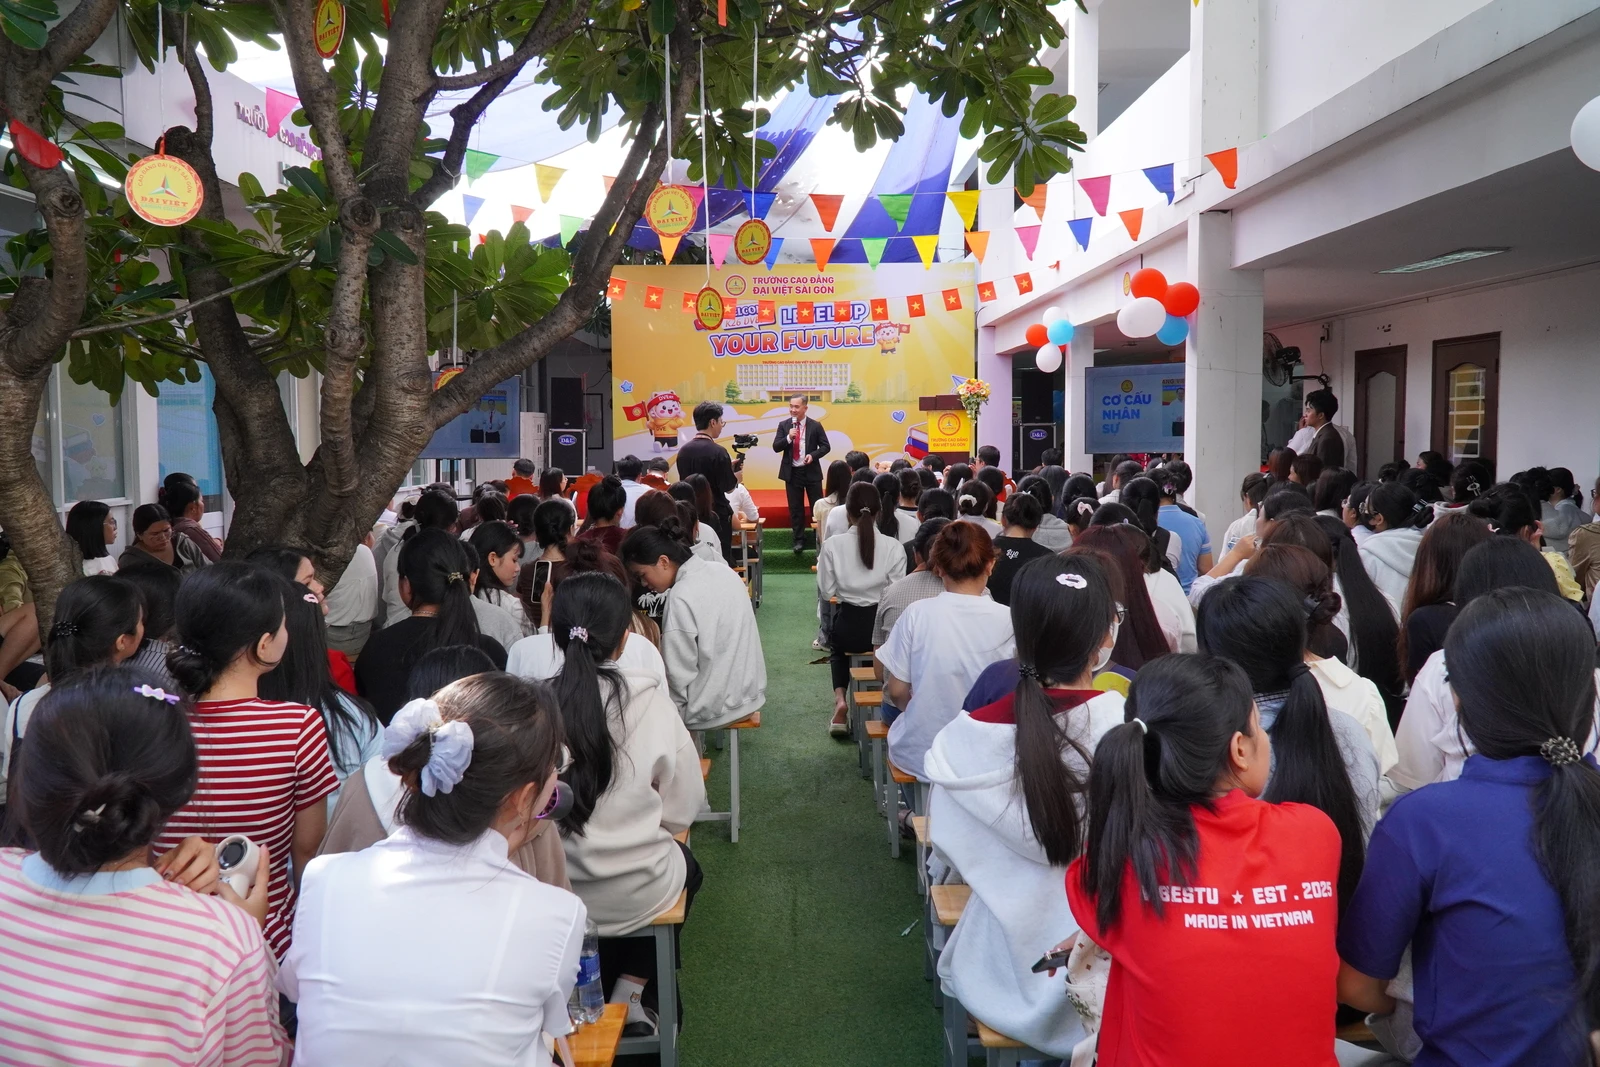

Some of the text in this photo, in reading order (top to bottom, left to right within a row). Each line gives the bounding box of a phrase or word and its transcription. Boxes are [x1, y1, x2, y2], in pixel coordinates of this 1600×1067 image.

[753, 274, 834, 284] TRƯỜNG CAO ĐẲNG
[753, 284, 834, 296] ĐẠI VIỆT SÀI GÒN
[710, 325, 875, 355] YOUR FUTURE
[1102, 391, 1152, 406] CƠ CẤU
[1102, 407, 1140, 420] NHÂN
[1102, 422, 1121, 436] SỰ
[1301, 881, 1333, 899] 2025
[1184, 910, 1314, 929] MADE IN VIETNAM
